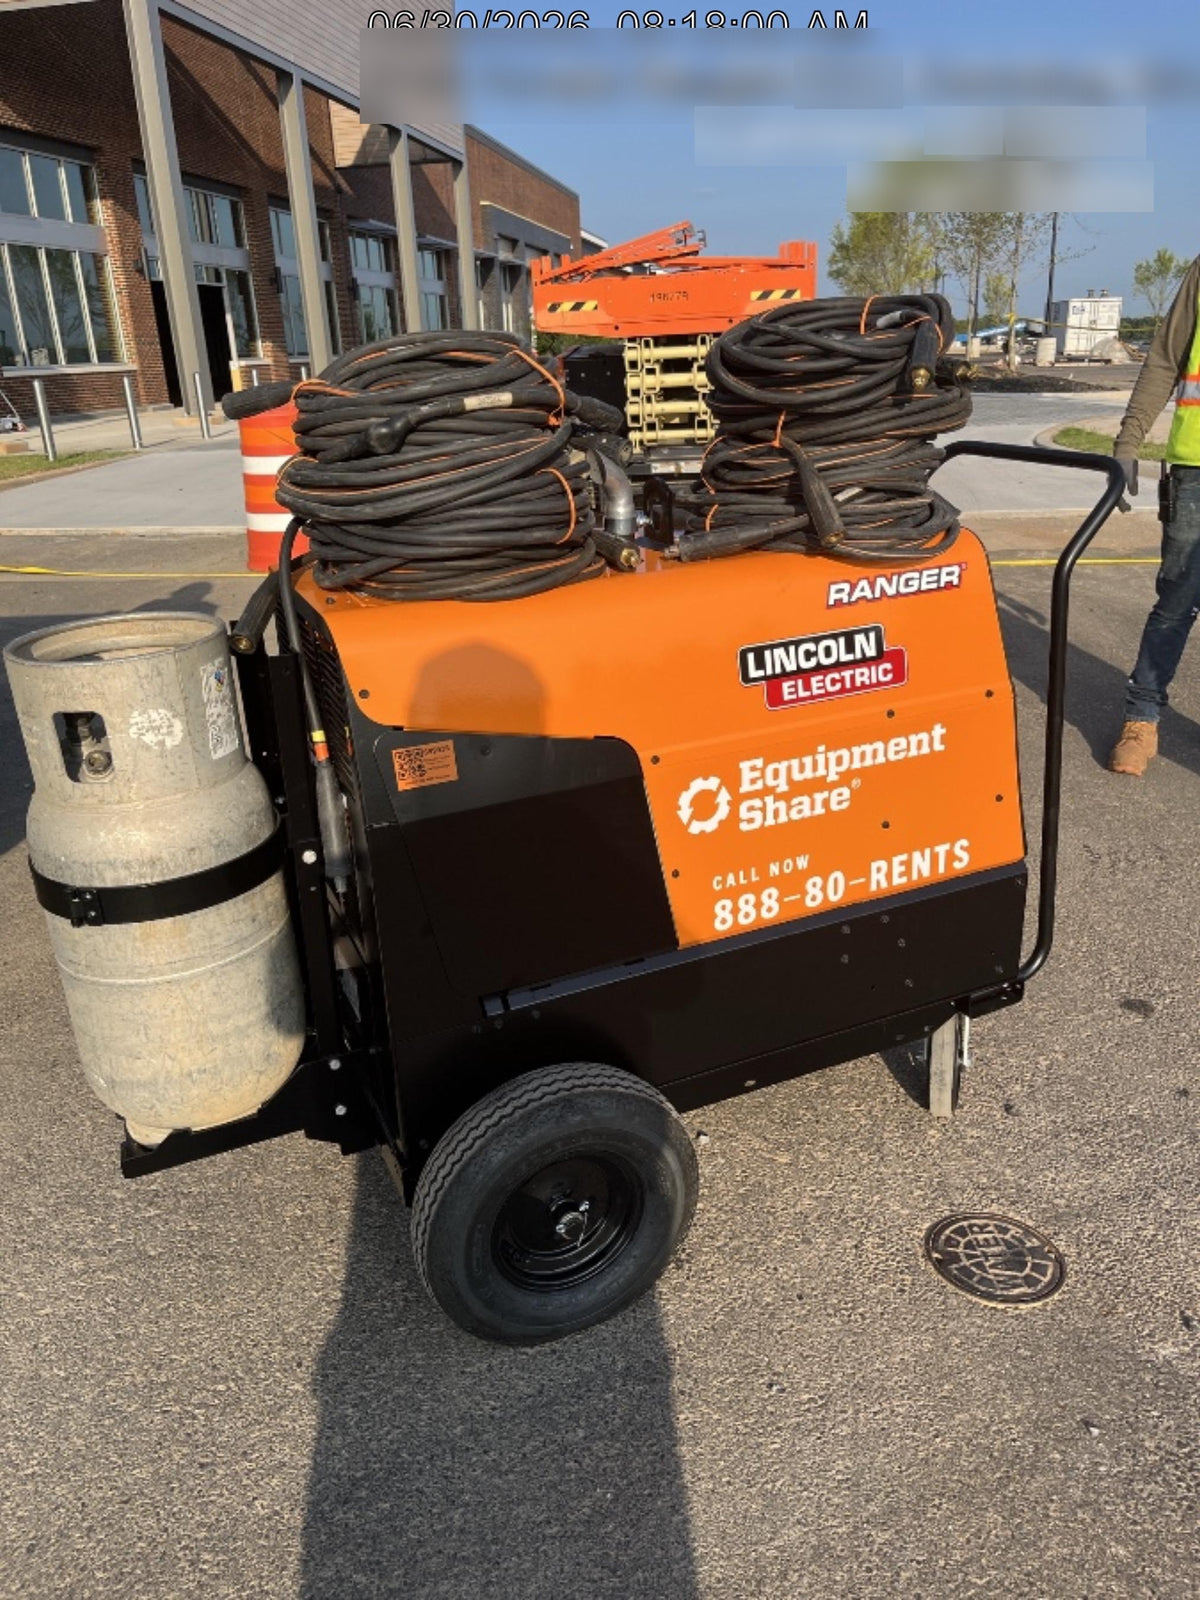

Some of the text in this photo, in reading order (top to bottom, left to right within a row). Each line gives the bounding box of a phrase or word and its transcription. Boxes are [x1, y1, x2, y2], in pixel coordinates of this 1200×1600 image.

[827, 564, 962, 607] RANGER
[747, 630, 877, 679] LINCOLN
[781, 662, 894, 702] ELECTRIC
[739, 723, 946, 793] Equipment
[712, 854, 810, 891] CALL NOW
[713, 838, 970, 932] 888-80-RENTS
